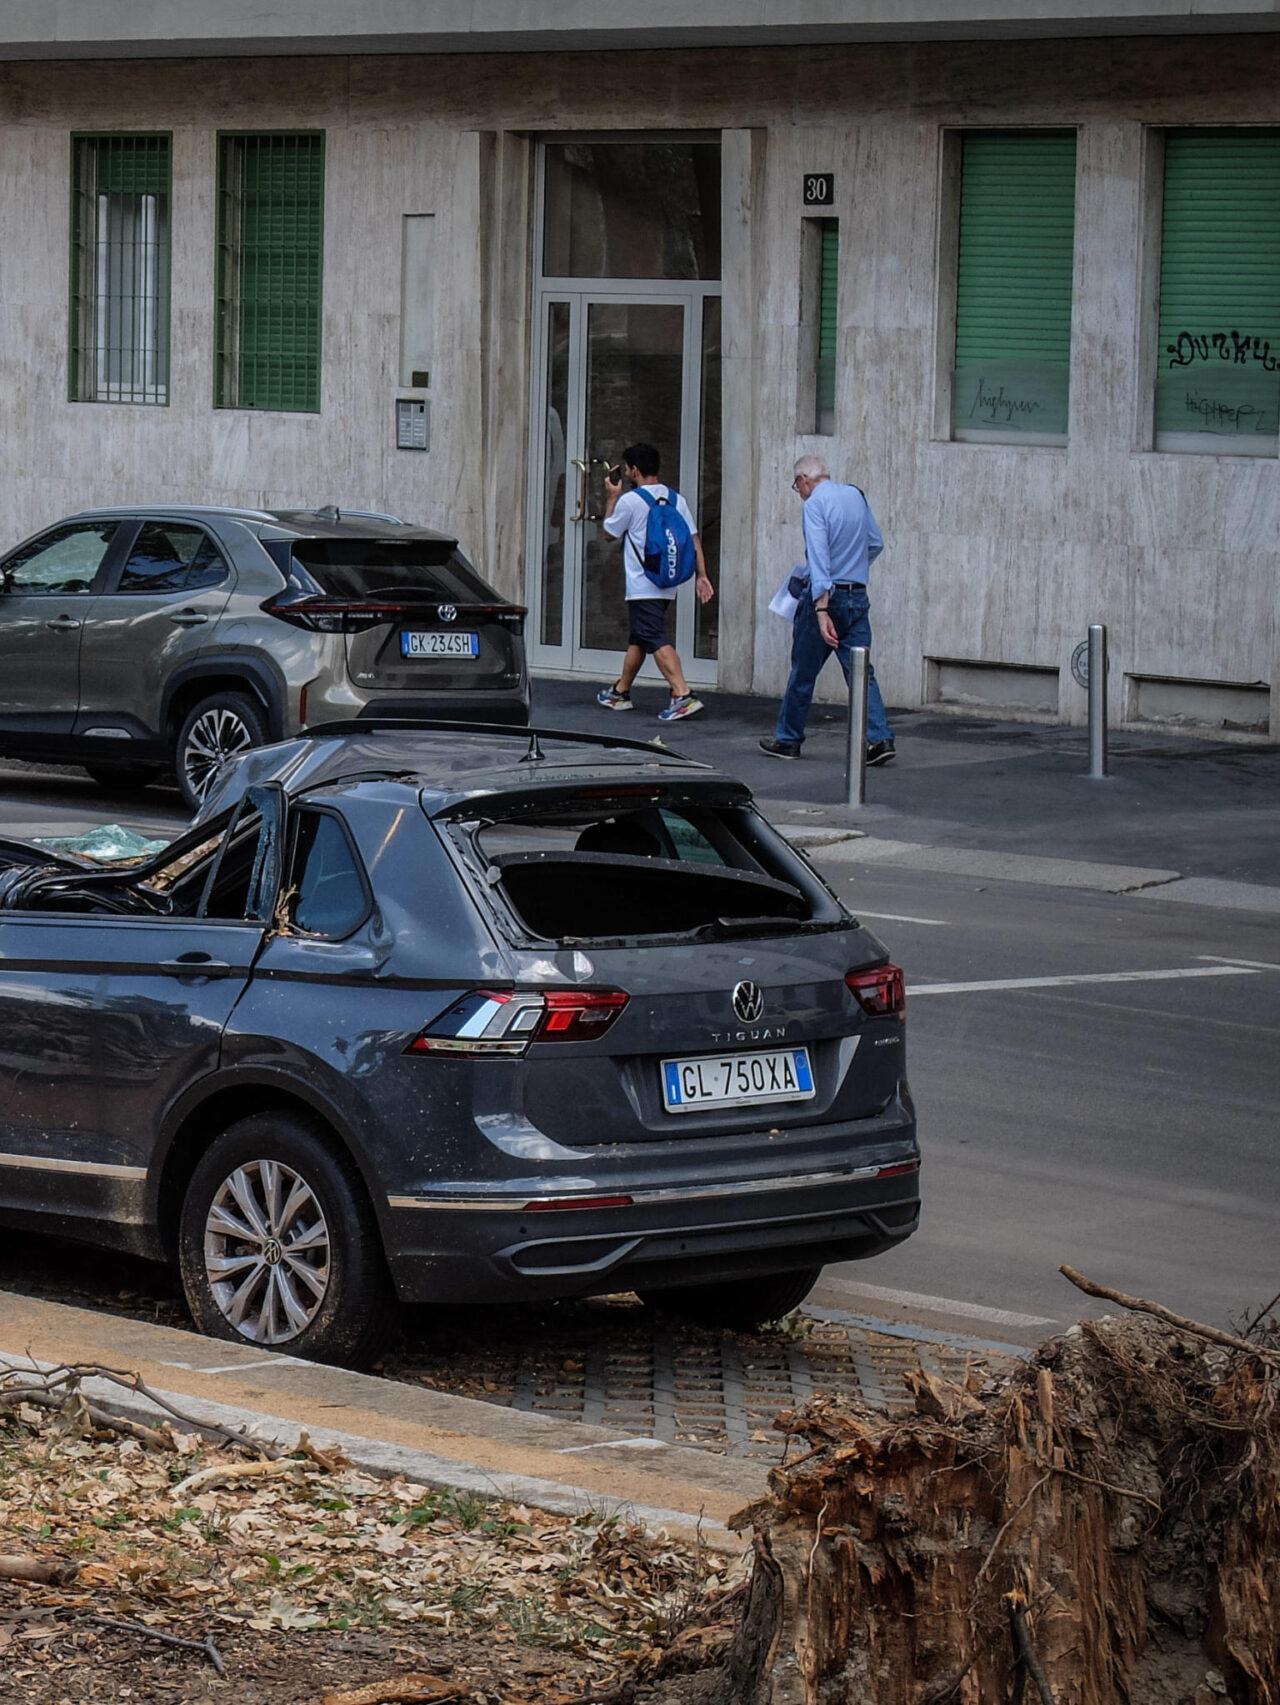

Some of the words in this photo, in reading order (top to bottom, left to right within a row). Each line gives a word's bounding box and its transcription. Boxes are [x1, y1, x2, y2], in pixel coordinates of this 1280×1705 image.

[807, 178, 827, 200] 30
[665, 529, 677, 579] adidas
[411, 635, 426, 652] GK
[431, 635, 470, 652] 234SH
[712, 1028, 786, 1043] TIGUAN
[682, 1064, 713, 1098] GL
[720, 1056, 796, 1095] 750XA
